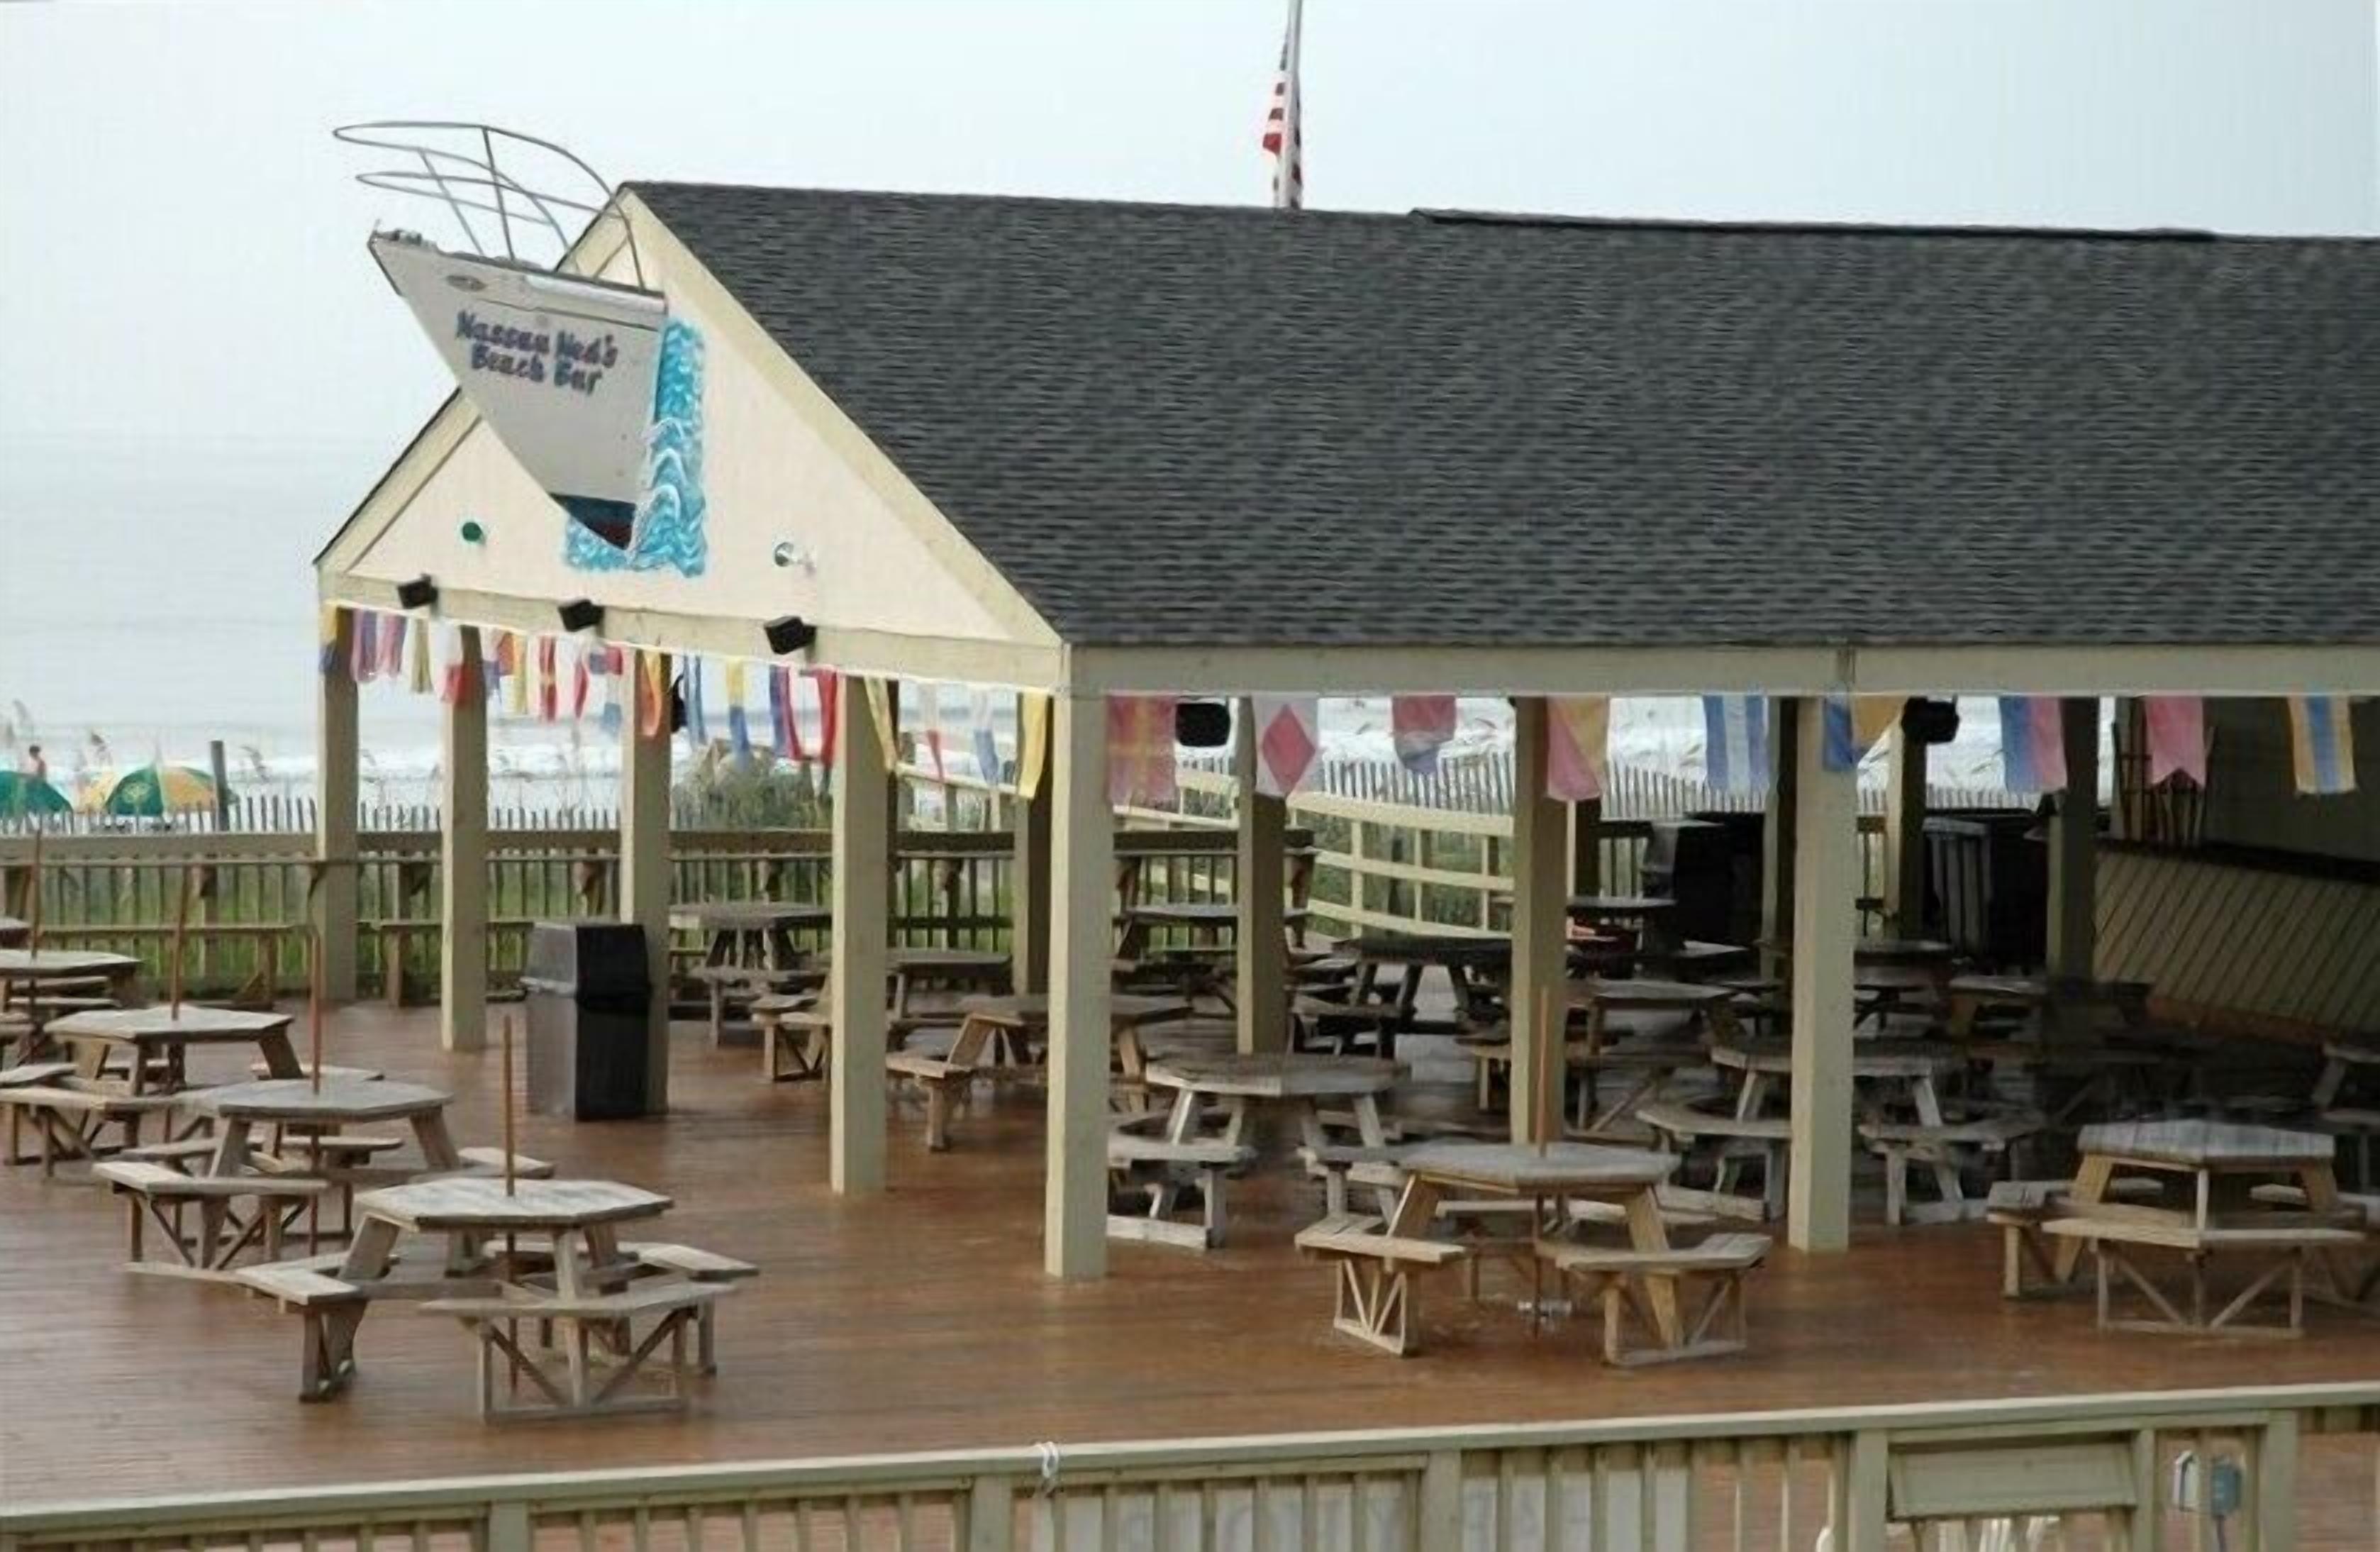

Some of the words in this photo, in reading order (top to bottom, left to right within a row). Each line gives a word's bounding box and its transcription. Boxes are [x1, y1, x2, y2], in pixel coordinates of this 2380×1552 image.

[472, 343, 544, 382] Beach
[554, 357, 603, 396] Bar
[555, 329, 618, 368] Ned's
